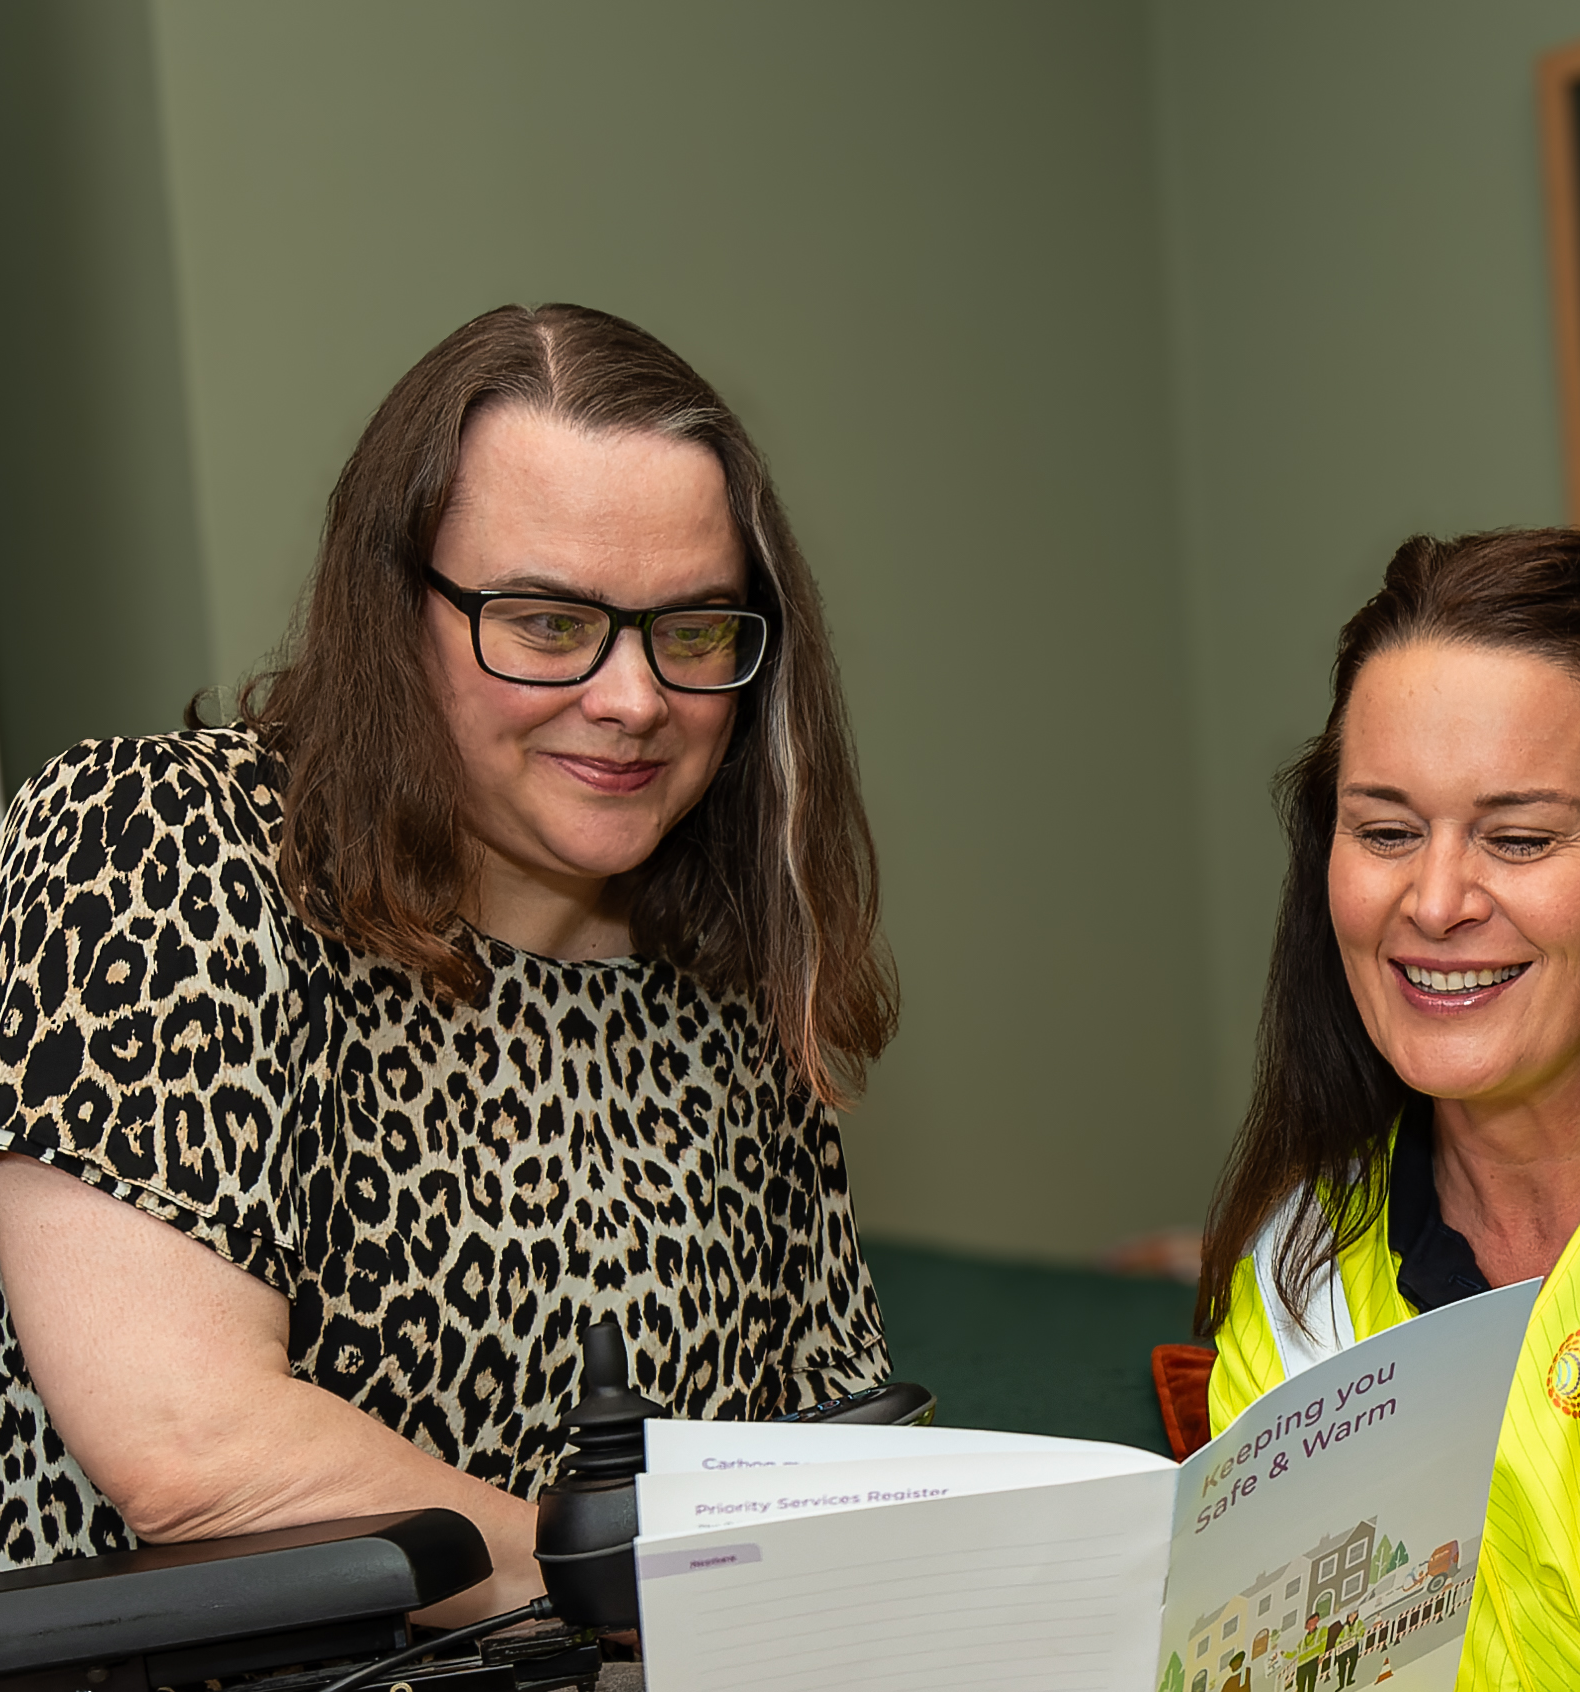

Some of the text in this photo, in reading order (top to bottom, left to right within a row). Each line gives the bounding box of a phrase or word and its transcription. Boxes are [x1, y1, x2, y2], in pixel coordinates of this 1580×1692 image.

[1195, 1398, 1397, 1534] Safe & Warm
[1202, 1362, 1396, 1498] Keeping you
[695, 1487, 950, 1516] Priority Services Register
